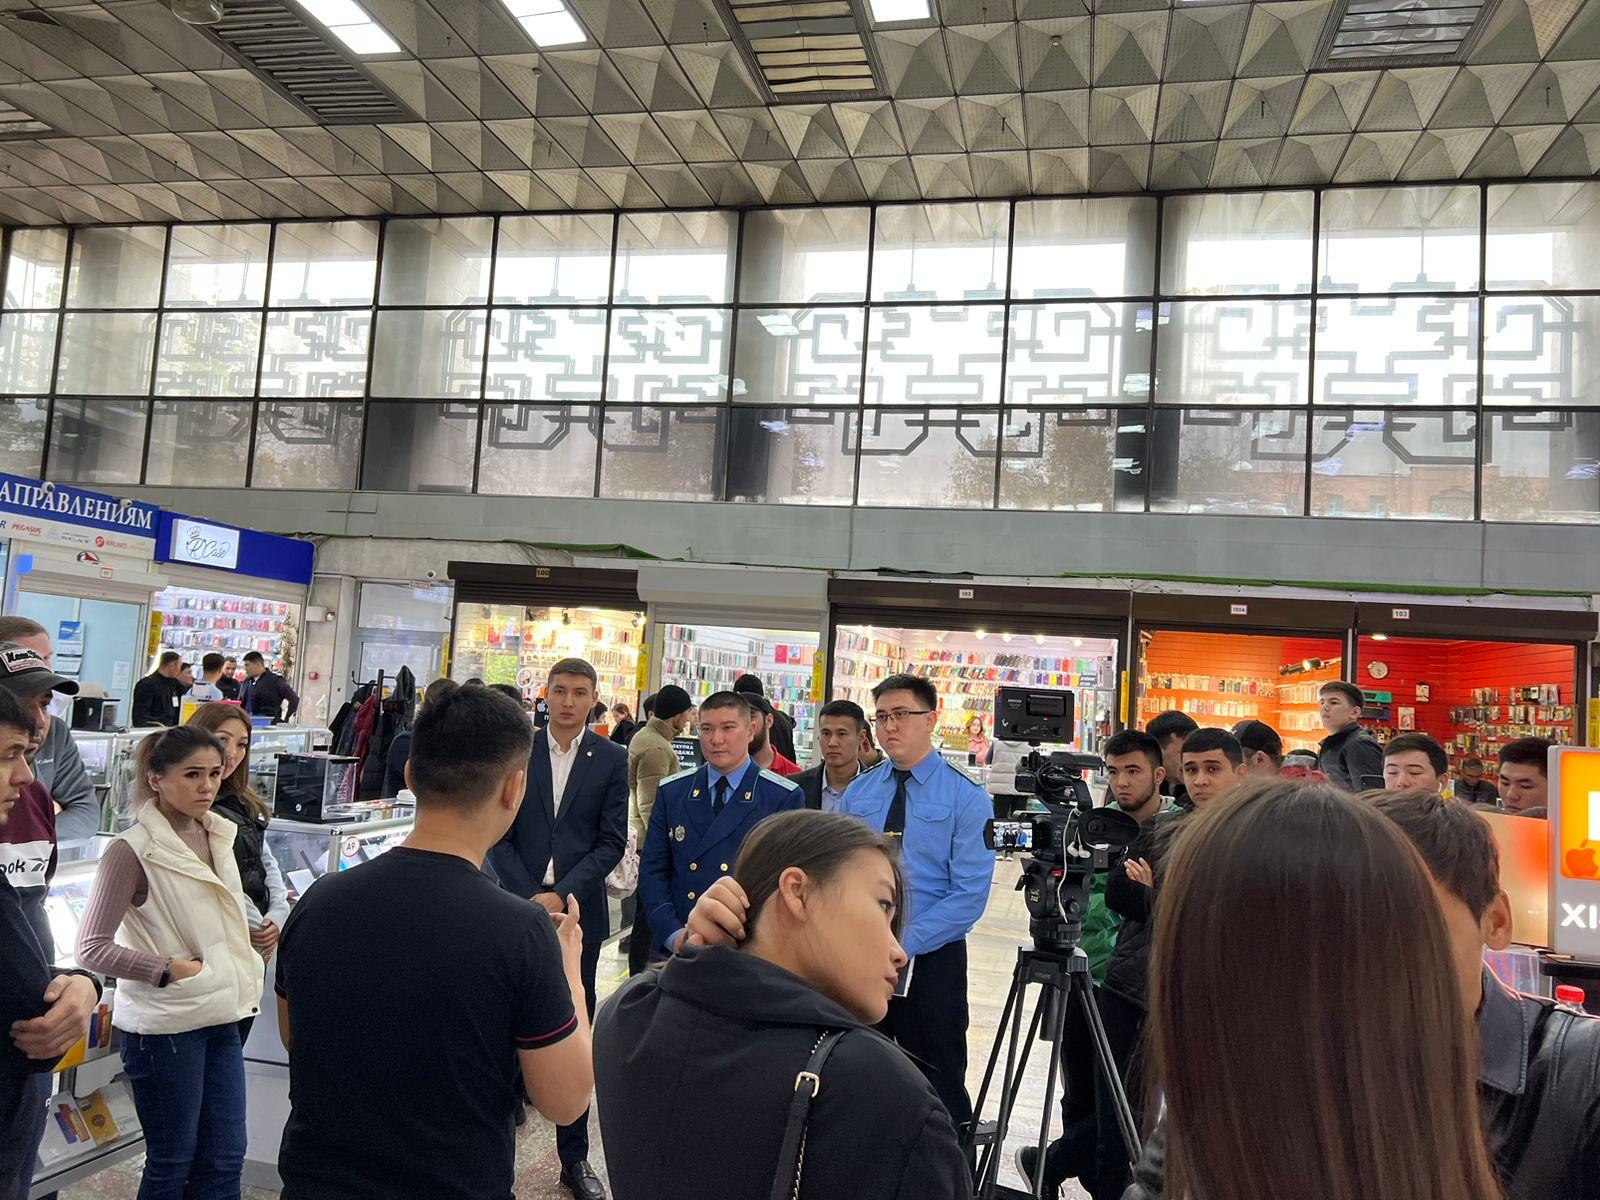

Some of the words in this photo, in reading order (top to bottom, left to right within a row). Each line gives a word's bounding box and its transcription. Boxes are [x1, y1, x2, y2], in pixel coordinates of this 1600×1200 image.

[0, 481, 153, 529] АПРАВЛЕНИЯМ
[11, 523, 42, 533] PEGASUS
[1561, 903, 1600, 929] XI
